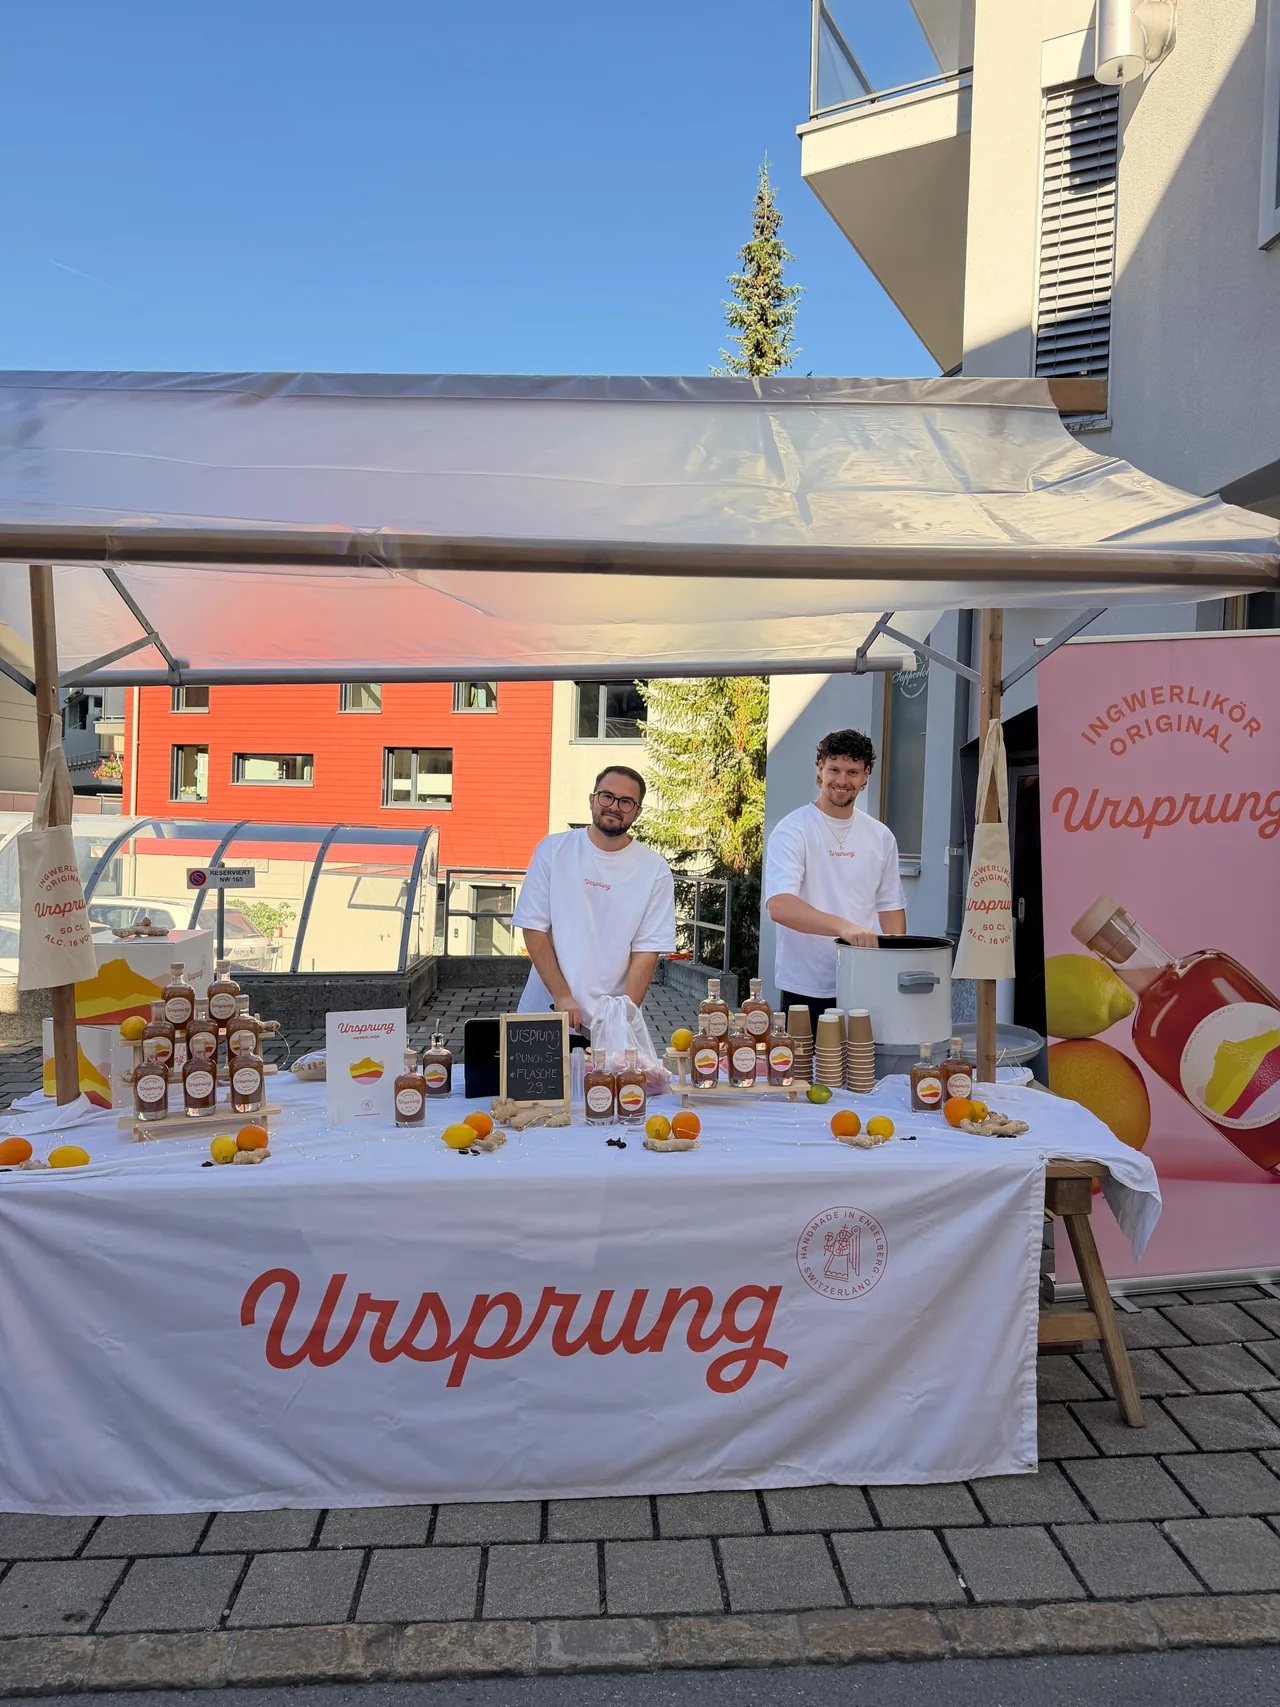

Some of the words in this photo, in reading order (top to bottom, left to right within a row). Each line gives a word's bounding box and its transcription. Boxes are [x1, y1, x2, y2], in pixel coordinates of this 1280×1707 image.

[1081, 684, 1262, 746] INGWERLIKÖR
[1109, 713, 1233, 756] ORIGINAL
[1052, 786, 1280, 840] Ursprung
[973, 873, 1010, 888] ORIGINAL
[60, 926, 73, 935] 50
[74, 923, 85, 931] CL
[996, 923, 1006, 931] CL
[45, 934, 66, 947] ALC.
[967, 928, 986, 943] ALC.
[989, 937, 998, 945] 16
[337, 1022, 396, 1035] Ursprung
[509, 1029, 560, 1050] Ursprung
[515, 1052, 543, 1064] PUNCH
[516, 1068, 558, 1080] FLASCHE
[800, 1211, 839, 1260] HANDMADE
[844, 1210, 856, 1219] IN
[858, 1215, 884, 1274] ENGELBERG
[803, 1266, 871, 1296] SWITZERLAND
[240, 1267, 789, 1394] Ursprung
